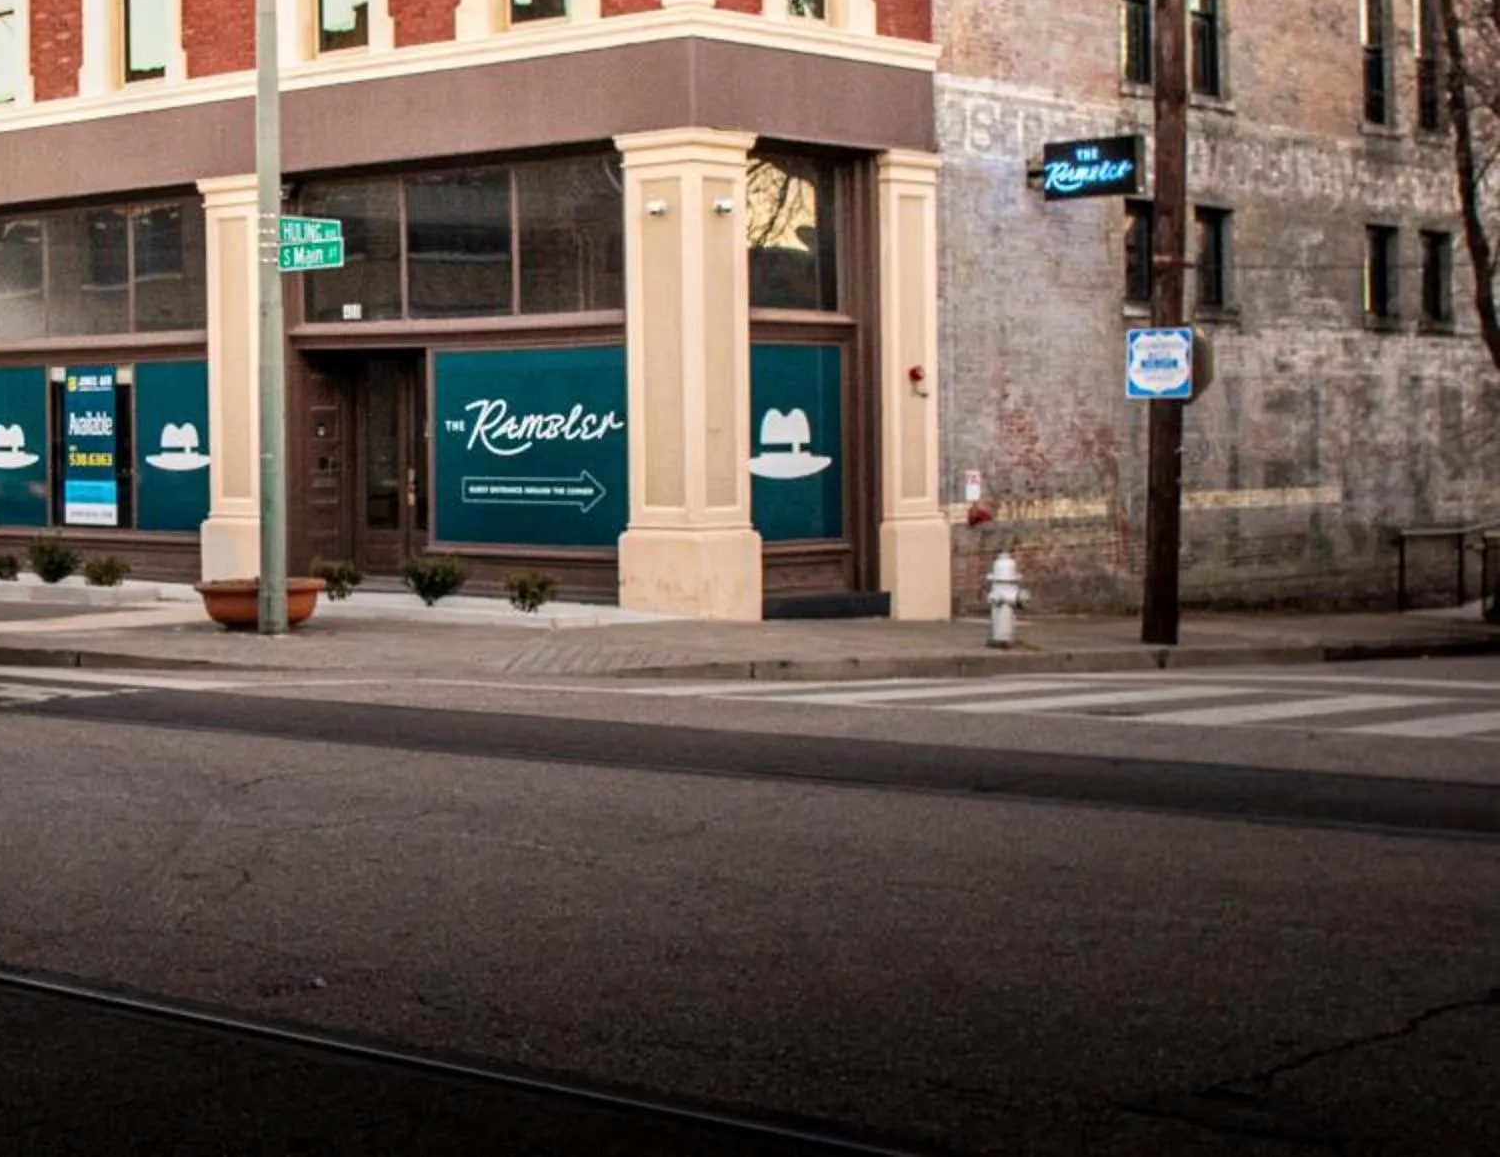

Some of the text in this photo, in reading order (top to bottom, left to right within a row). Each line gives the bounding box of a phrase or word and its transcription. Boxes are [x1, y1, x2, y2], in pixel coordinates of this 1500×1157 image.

[1076, 146, 1098, 161] THE
[283, 248, 291, 265] S
[294, 245, 323, 267] Main
[68, 410, 113, 436] Available
[445, 420, 465, 431] THE
